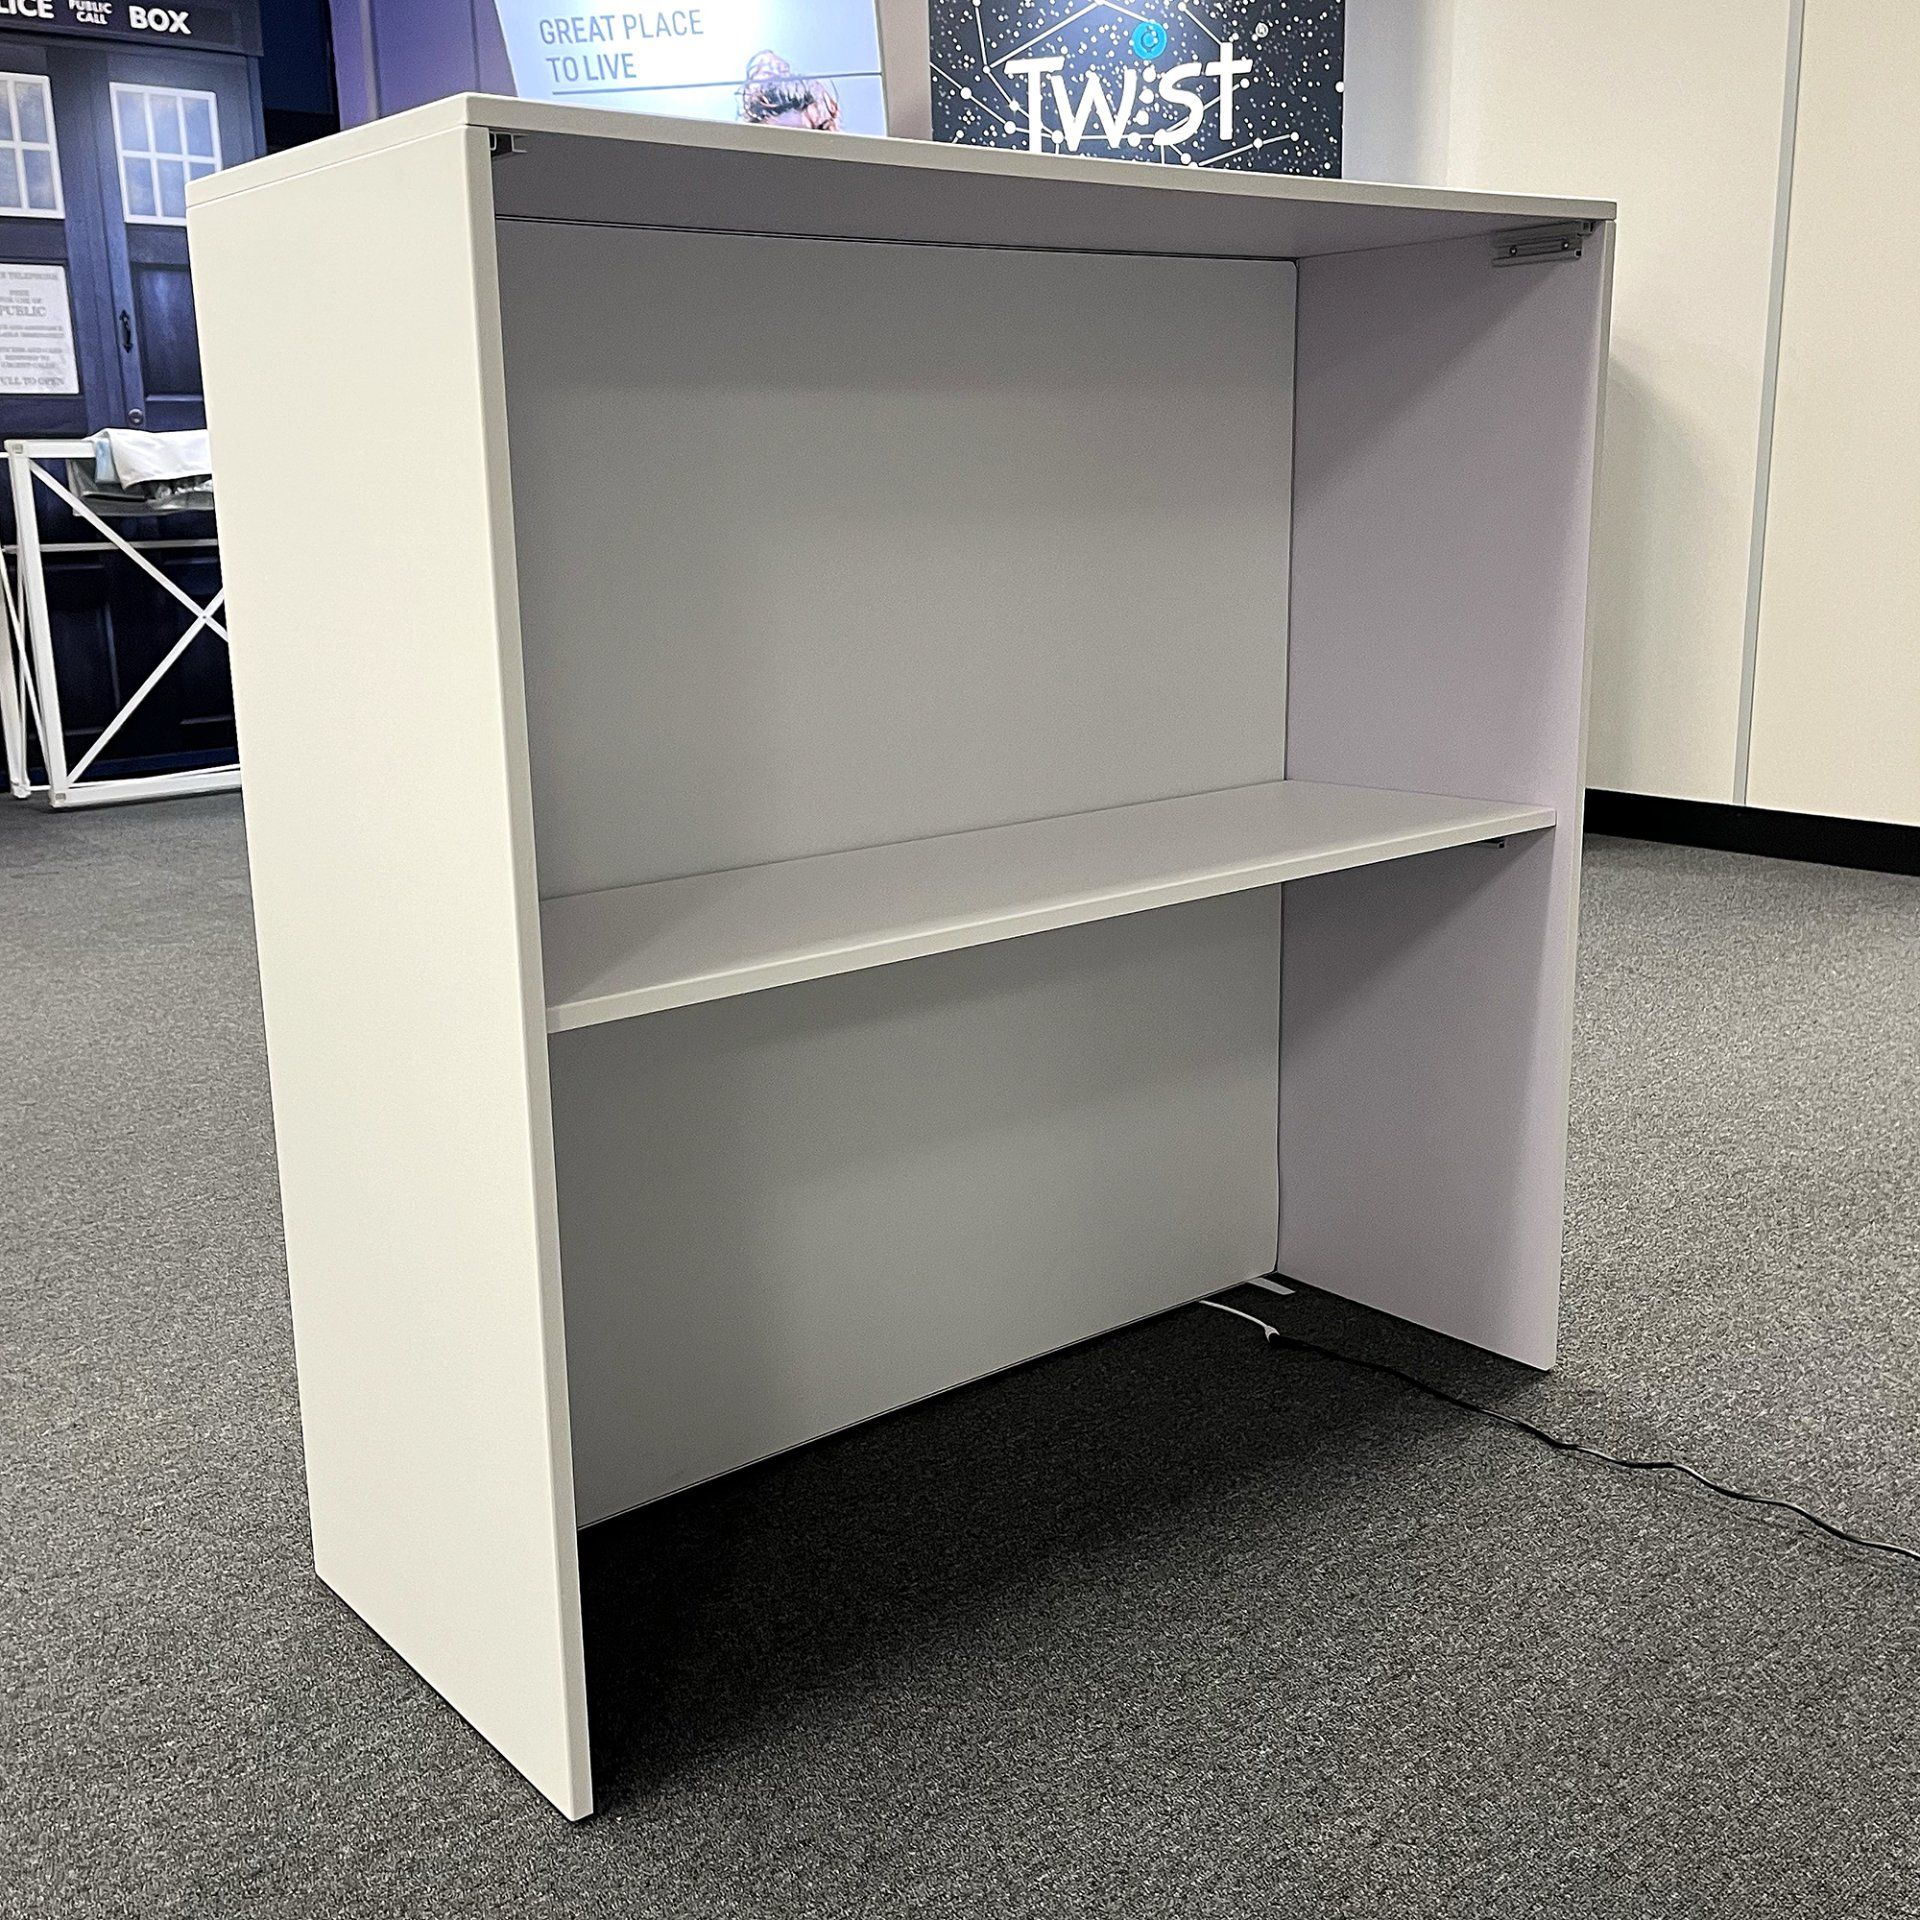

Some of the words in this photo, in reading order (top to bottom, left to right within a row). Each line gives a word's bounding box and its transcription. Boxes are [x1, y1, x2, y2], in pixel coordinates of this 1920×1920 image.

[68, 0, 113, 14] PUBLIC
[76, 11, 108, 25] CALL
[128, 5, 192, 35] BOX
[539, 15, 616, 45] GREAT
[622, 9, 704, 40] PLACE
[546, 56, 579, 83] TO
[583, 53, 637, 81] LIVE
